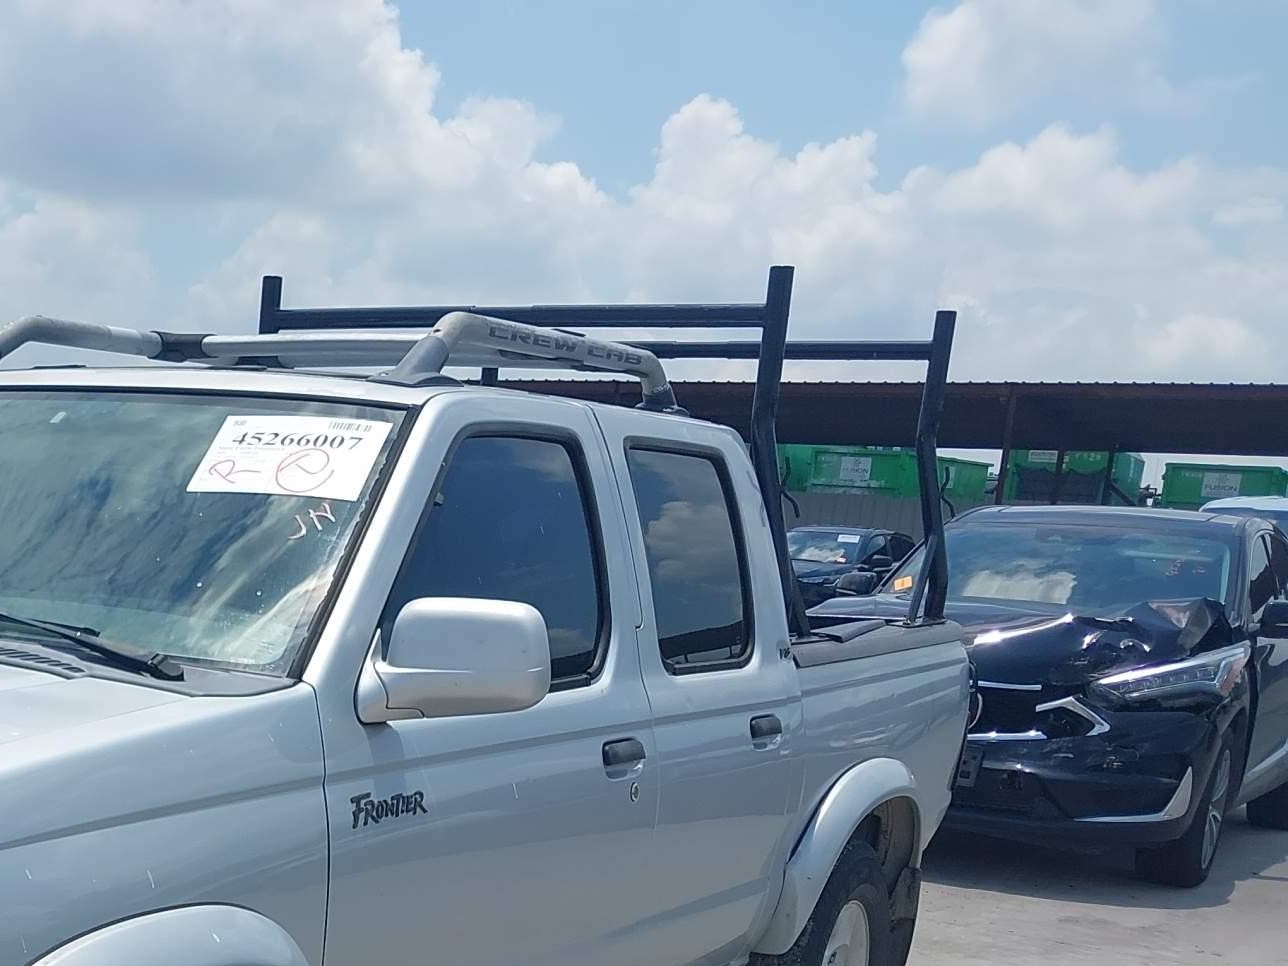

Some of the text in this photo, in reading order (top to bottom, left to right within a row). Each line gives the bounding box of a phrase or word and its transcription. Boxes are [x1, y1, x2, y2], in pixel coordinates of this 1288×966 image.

[488, 325, 643, 366] CREW CAB
[232, 431, 364, 451] 45266007
